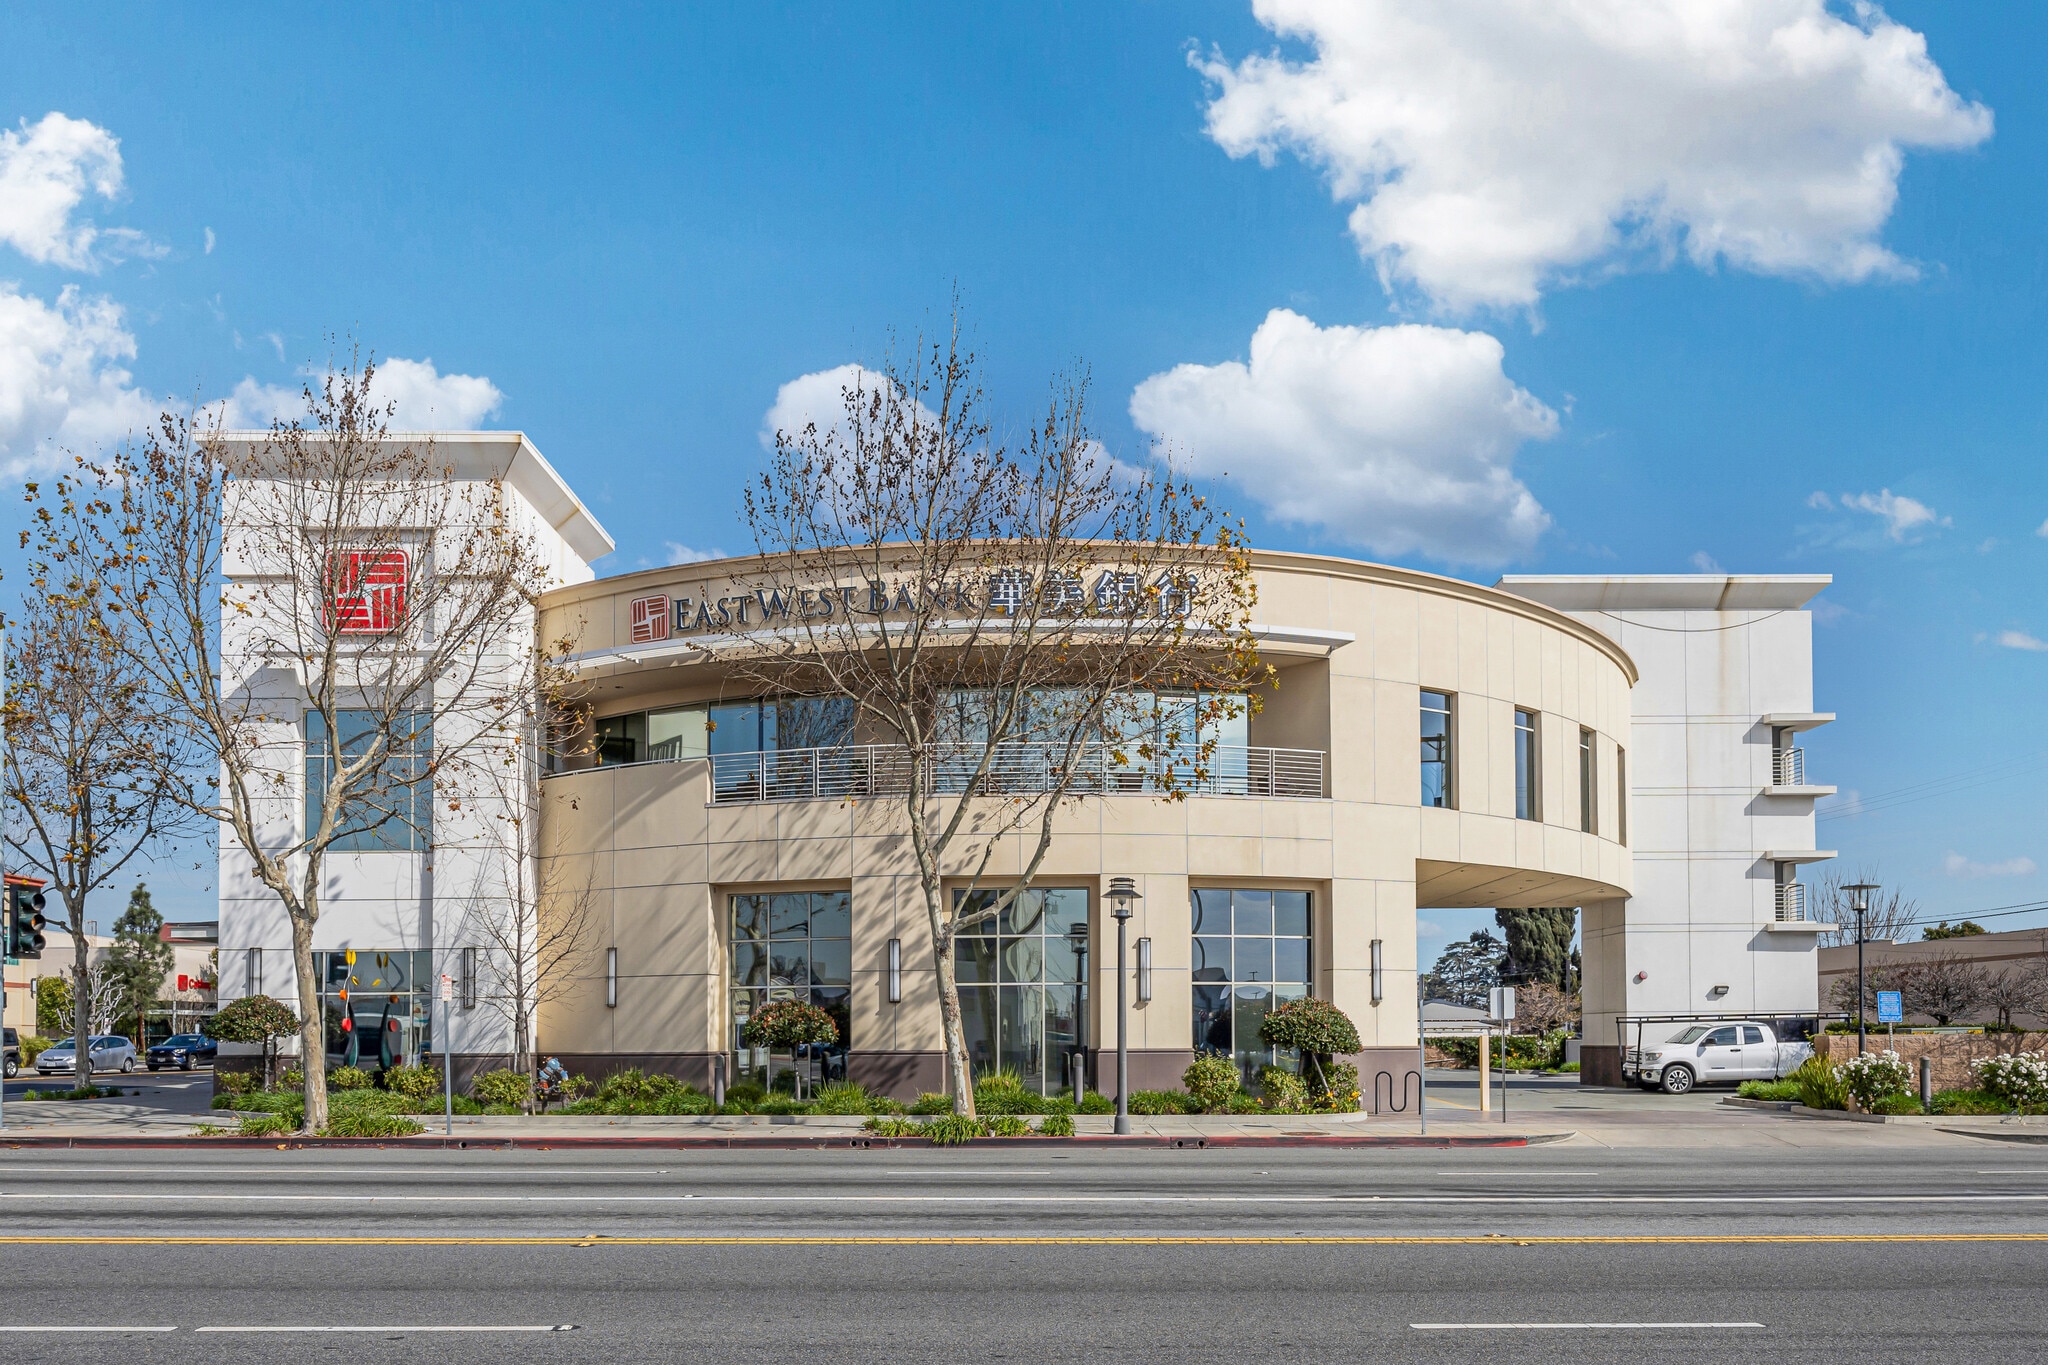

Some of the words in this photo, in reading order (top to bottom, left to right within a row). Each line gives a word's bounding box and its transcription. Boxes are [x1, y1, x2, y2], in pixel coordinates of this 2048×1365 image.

[869, 580, 980, 613] BANK
[989, 570, 1199, 618] 華美銀行
